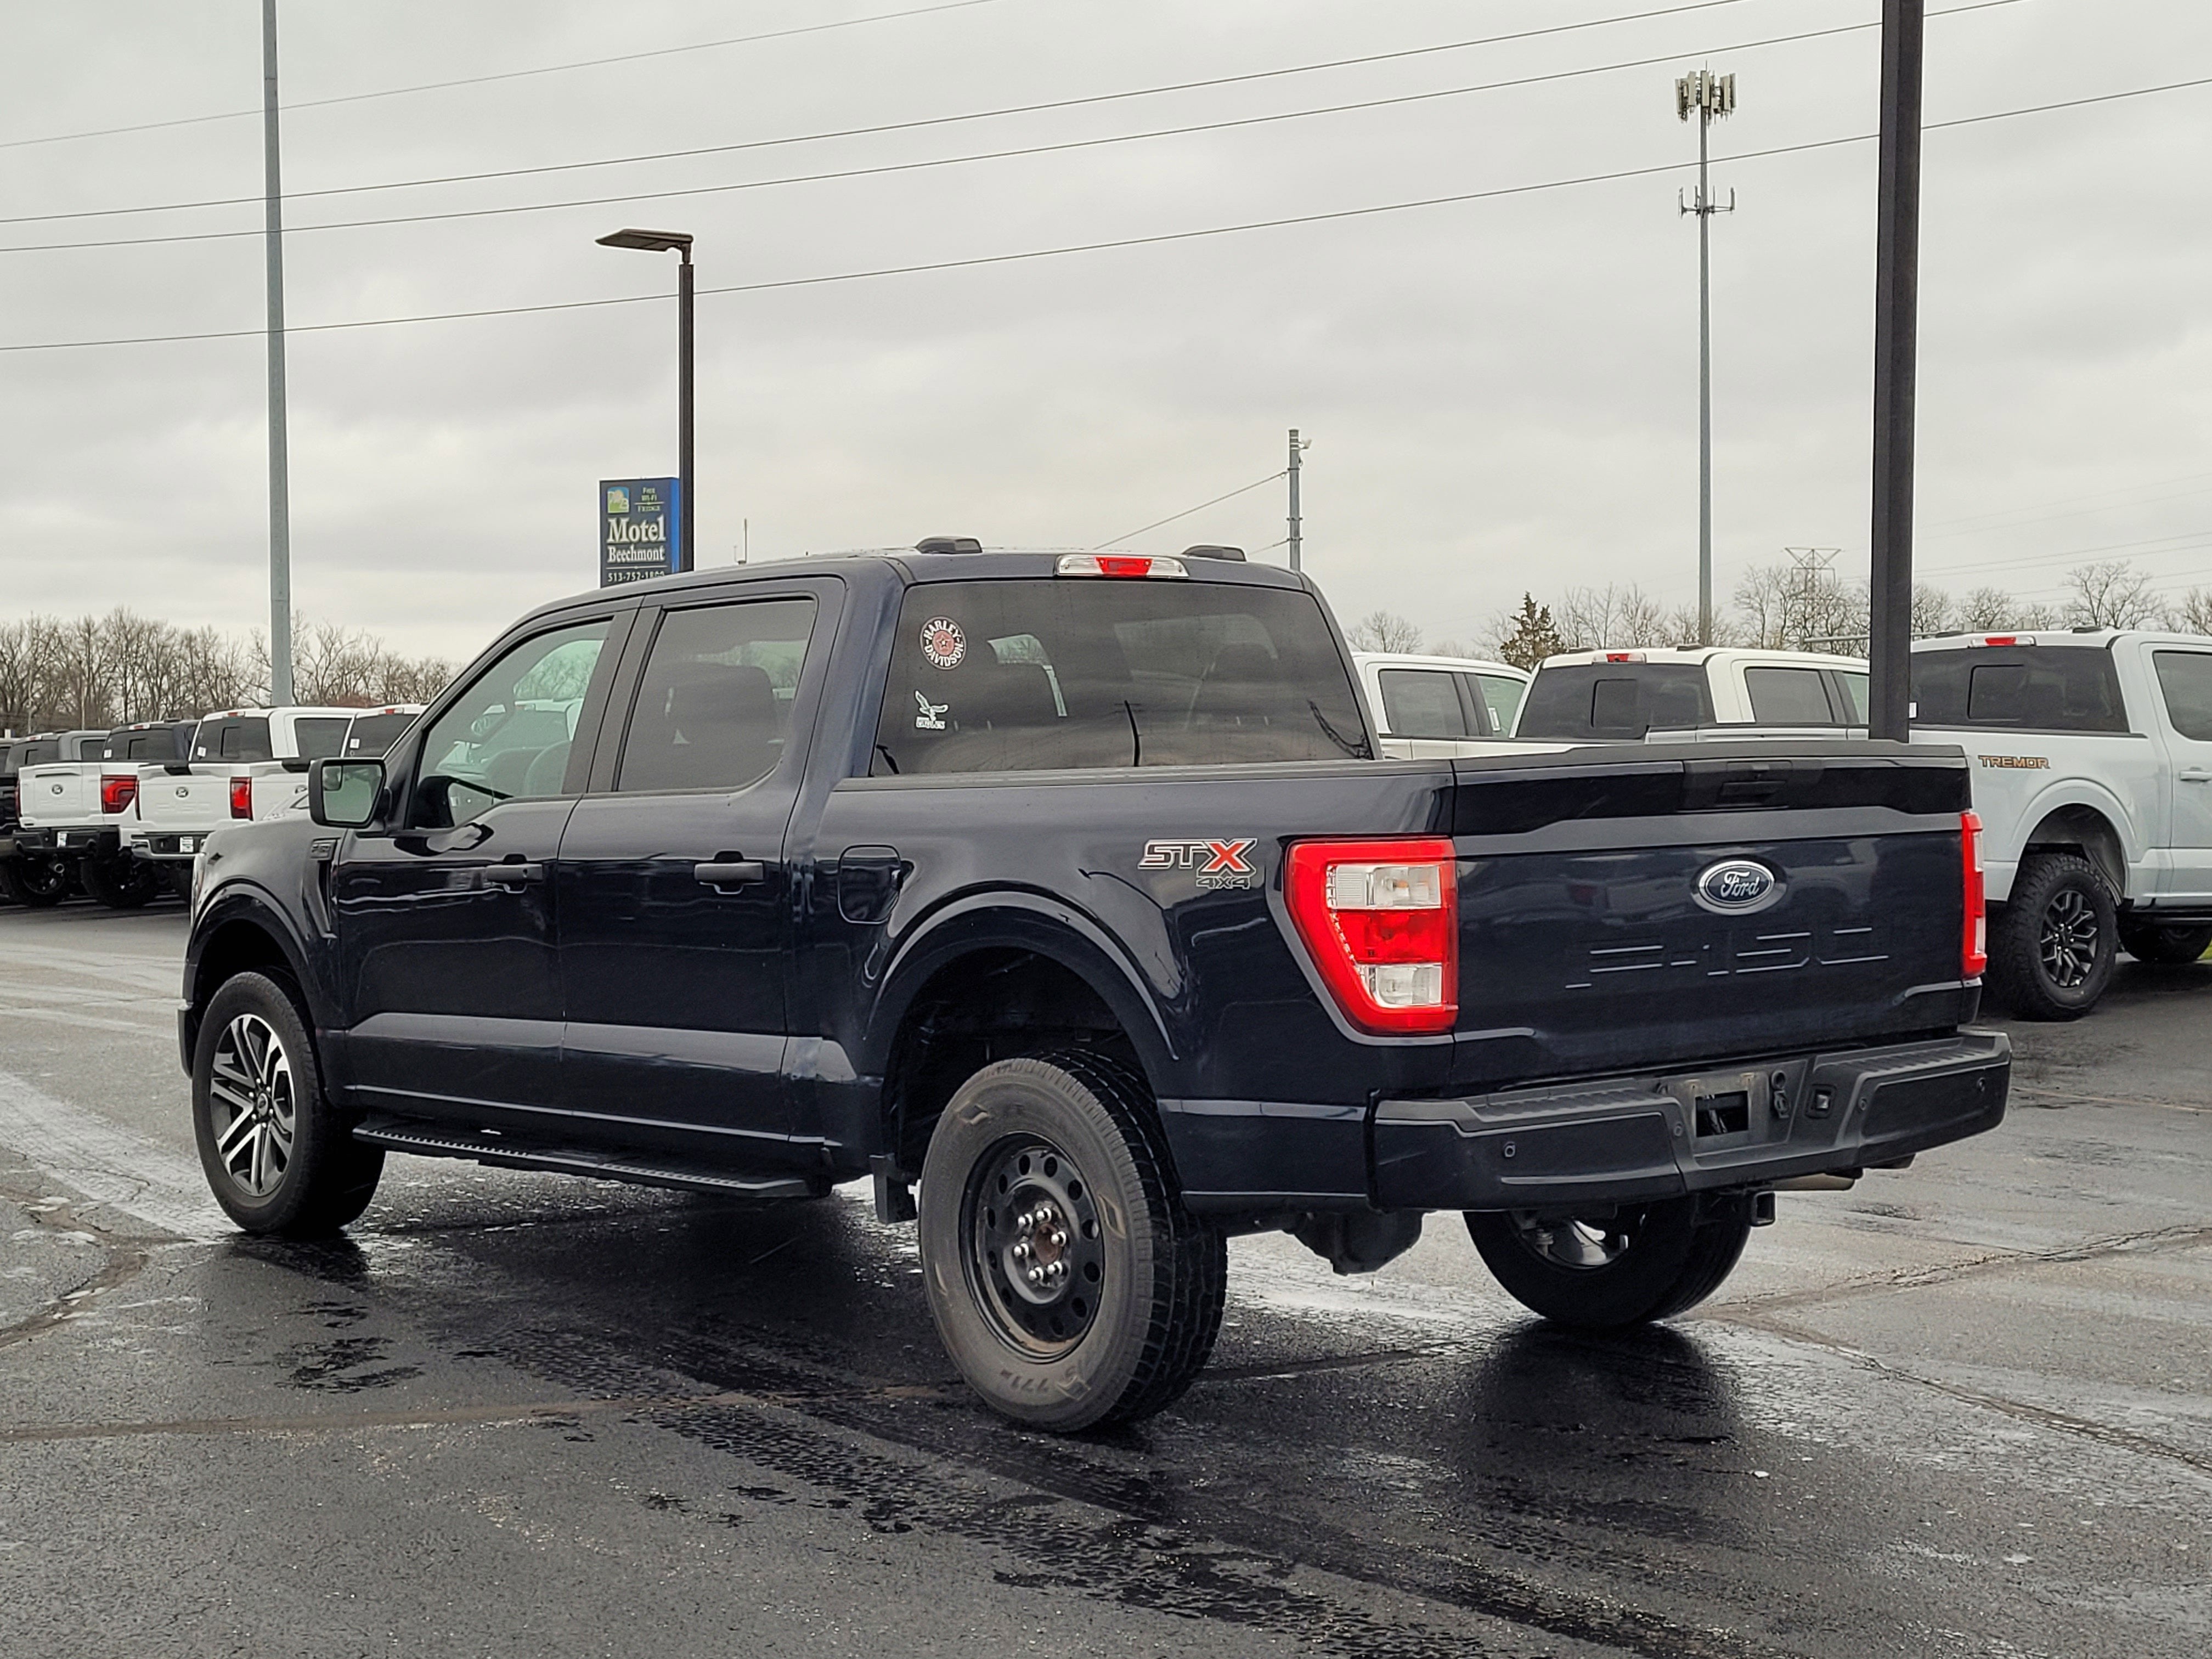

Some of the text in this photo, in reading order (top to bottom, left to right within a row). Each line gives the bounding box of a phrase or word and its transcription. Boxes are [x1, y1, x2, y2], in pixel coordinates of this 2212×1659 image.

[606, 514, 667, 543] Motel
[607, 544, 665, 563] Beechmont
[1978, 754, 2051, 770] TREMOR
[1137, 838, 1258, 878] STX
[1720, 871, 1761, 898] Ford
